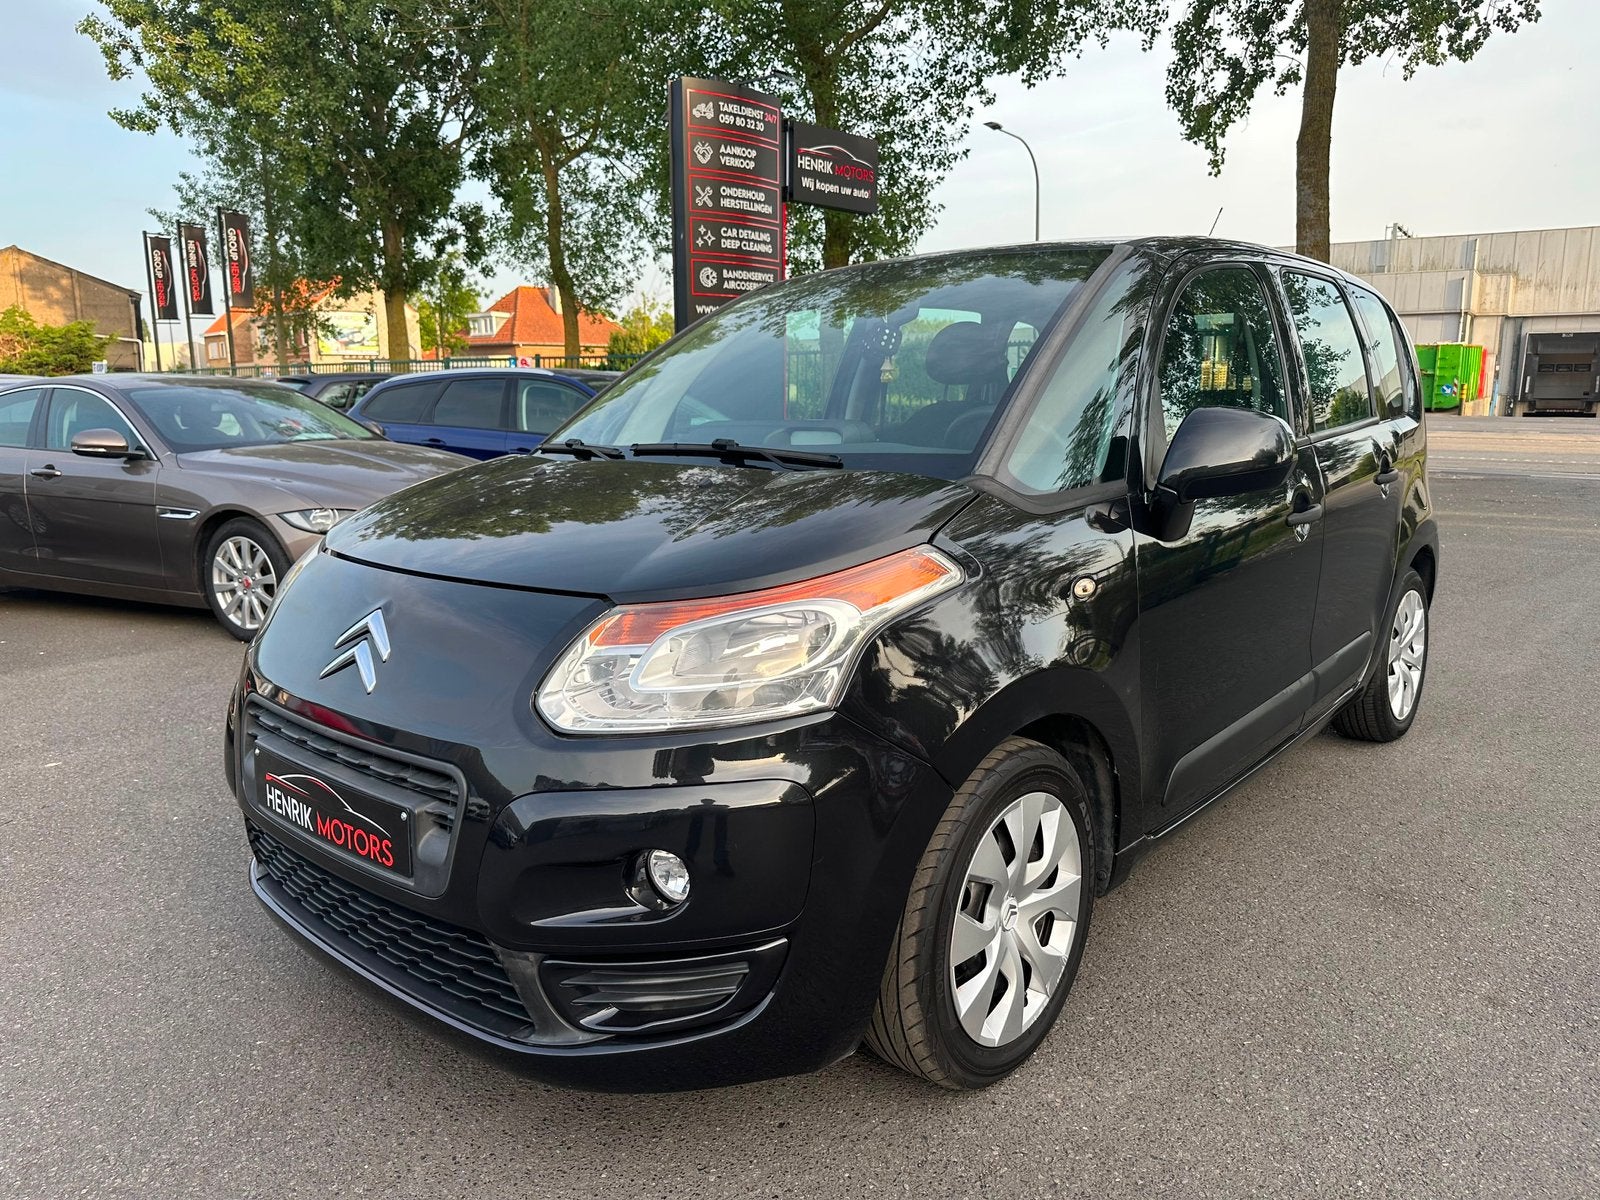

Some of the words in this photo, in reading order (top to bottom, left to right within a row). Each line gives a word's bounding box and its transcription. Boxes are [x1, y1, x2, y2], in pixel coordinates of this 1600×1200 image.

[718, 101, 764, 120] TAKELDIENST
[764, 112, 777, 124] 24/7
[719, 113, 734, 125] 059
[735, 116, 746, 127] 80
[746, 119, 756, 130] 32
[755, 120, 765, 132] 30
[720, 144, 757, 159] AANKOOP
[720, 156, 755, 170] VERKOOP
[797, 155, 833, 174] HENRIK
[834, 164, 874, 183] MOTORS
[720, 186, 765, 202] ONDERHOUD
[801, 176, 815, 192] Wij
[815, 179, 840, 194] kopen
[840, 186, 853, 196] uw
[720, 197, 773, 215] HERSTELLINGEN
[228, 228, 238, 261] GROUP
[720, 226, 738, 238] CAR
[738, 228, 771, 243] DETAILING
[187, 240, 197, 268] HENRIK
[721, 238, 741, 249] DEEP
[740, 240, 773, 254] CLEANING
[153, 249, 163, 279] GROUP
[190, 268, 200, 302] MOTORS
[231, 261, 241, 293] HENRIK
[722, 268, 774, 283] BANDENSERVICE
[156, 279, 166, 307] HENRIK
[265, 783, 314, 832] HENRIK
[316, 811, 394, 867] MOTORS
